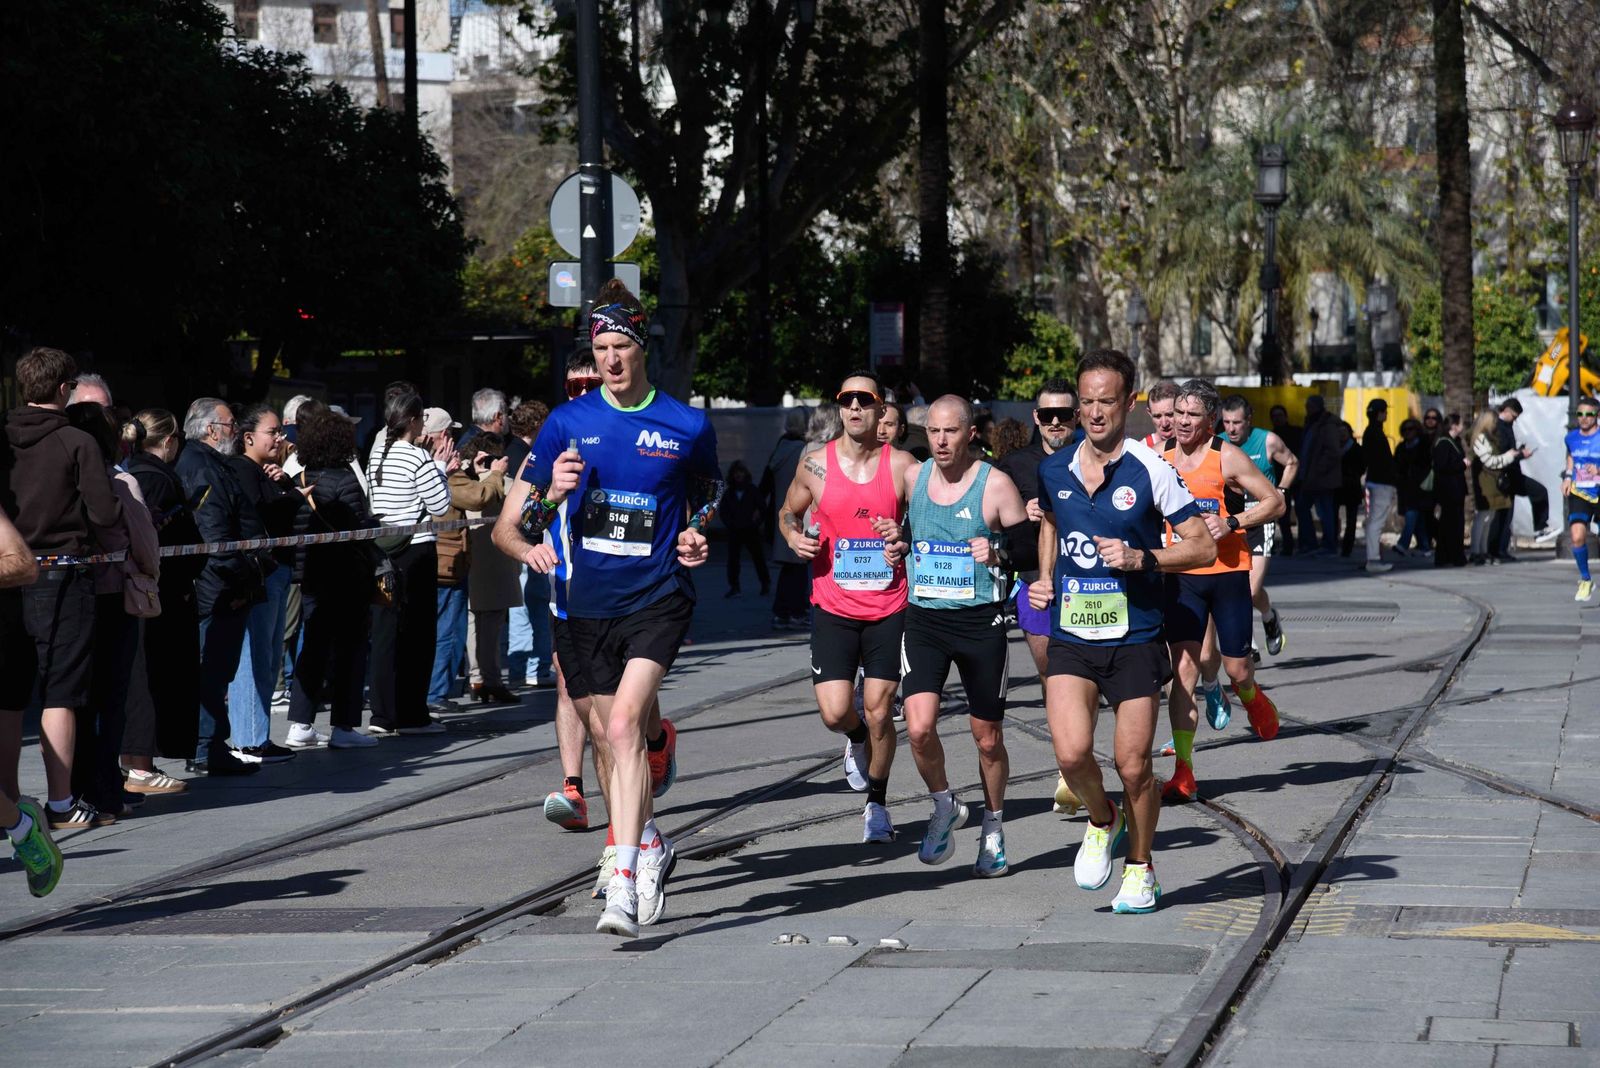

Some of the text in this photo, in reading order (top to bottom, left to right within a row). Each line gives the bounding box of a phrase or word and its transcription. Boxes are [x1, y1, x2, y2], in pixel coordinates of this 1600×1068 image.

[635, 429, 680, 451] Metz
[636, 448, 681, 460] Triathlon
[609, 494, 649, 506] ZURICH
[609, 512, 629, 524] 5148
[609, 525, 625, 540] JB
[933, 544, 967, 554] ZURICH
[854, 556, 872, 564] 6737
[934, 561, 952, 570] 6128
[833, 570, 893, 579] NICOLAS HENAULT
[915, 574, 974, 587] JOSE MANUEL
[1082, 581, 1118, 591] ZURICH
[1084, 600, 1102, 609] 2610
[1070, 611, 1118, 625] CARLOS
